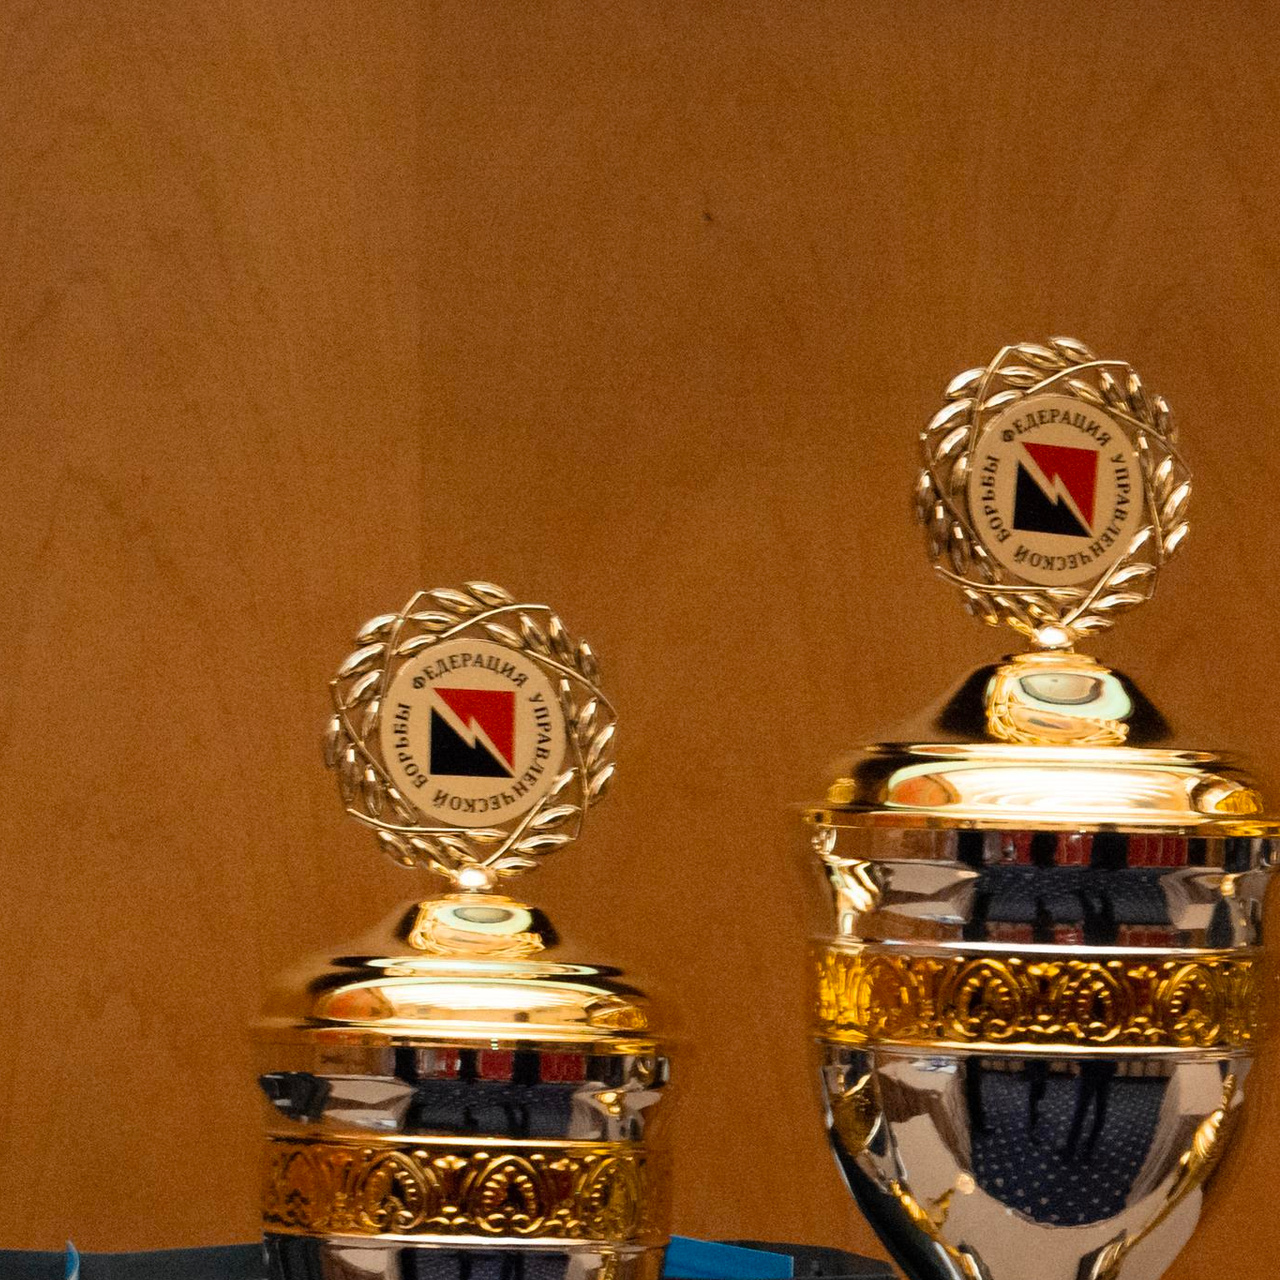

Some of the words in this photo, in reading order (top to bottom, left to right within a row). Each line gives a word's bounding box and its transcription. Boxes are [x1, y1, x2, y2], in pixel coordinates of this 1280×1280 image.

[1002, 409, 1113, 447] ФЕДЕРАЦИЯ
[981, 455, 1012, 543] БОРЬБЫ
[1014, 453, 1130, 571] УПРАВЛЕНЧЕСКОЙ
[412, 653, 529, 690] ФЕДЕРАЦИЯ
[394, 703, 429, 789] БОРЬБЫ
[432, 692, 552, 813] УПРАВЛЕНЧЕСКОЙ
